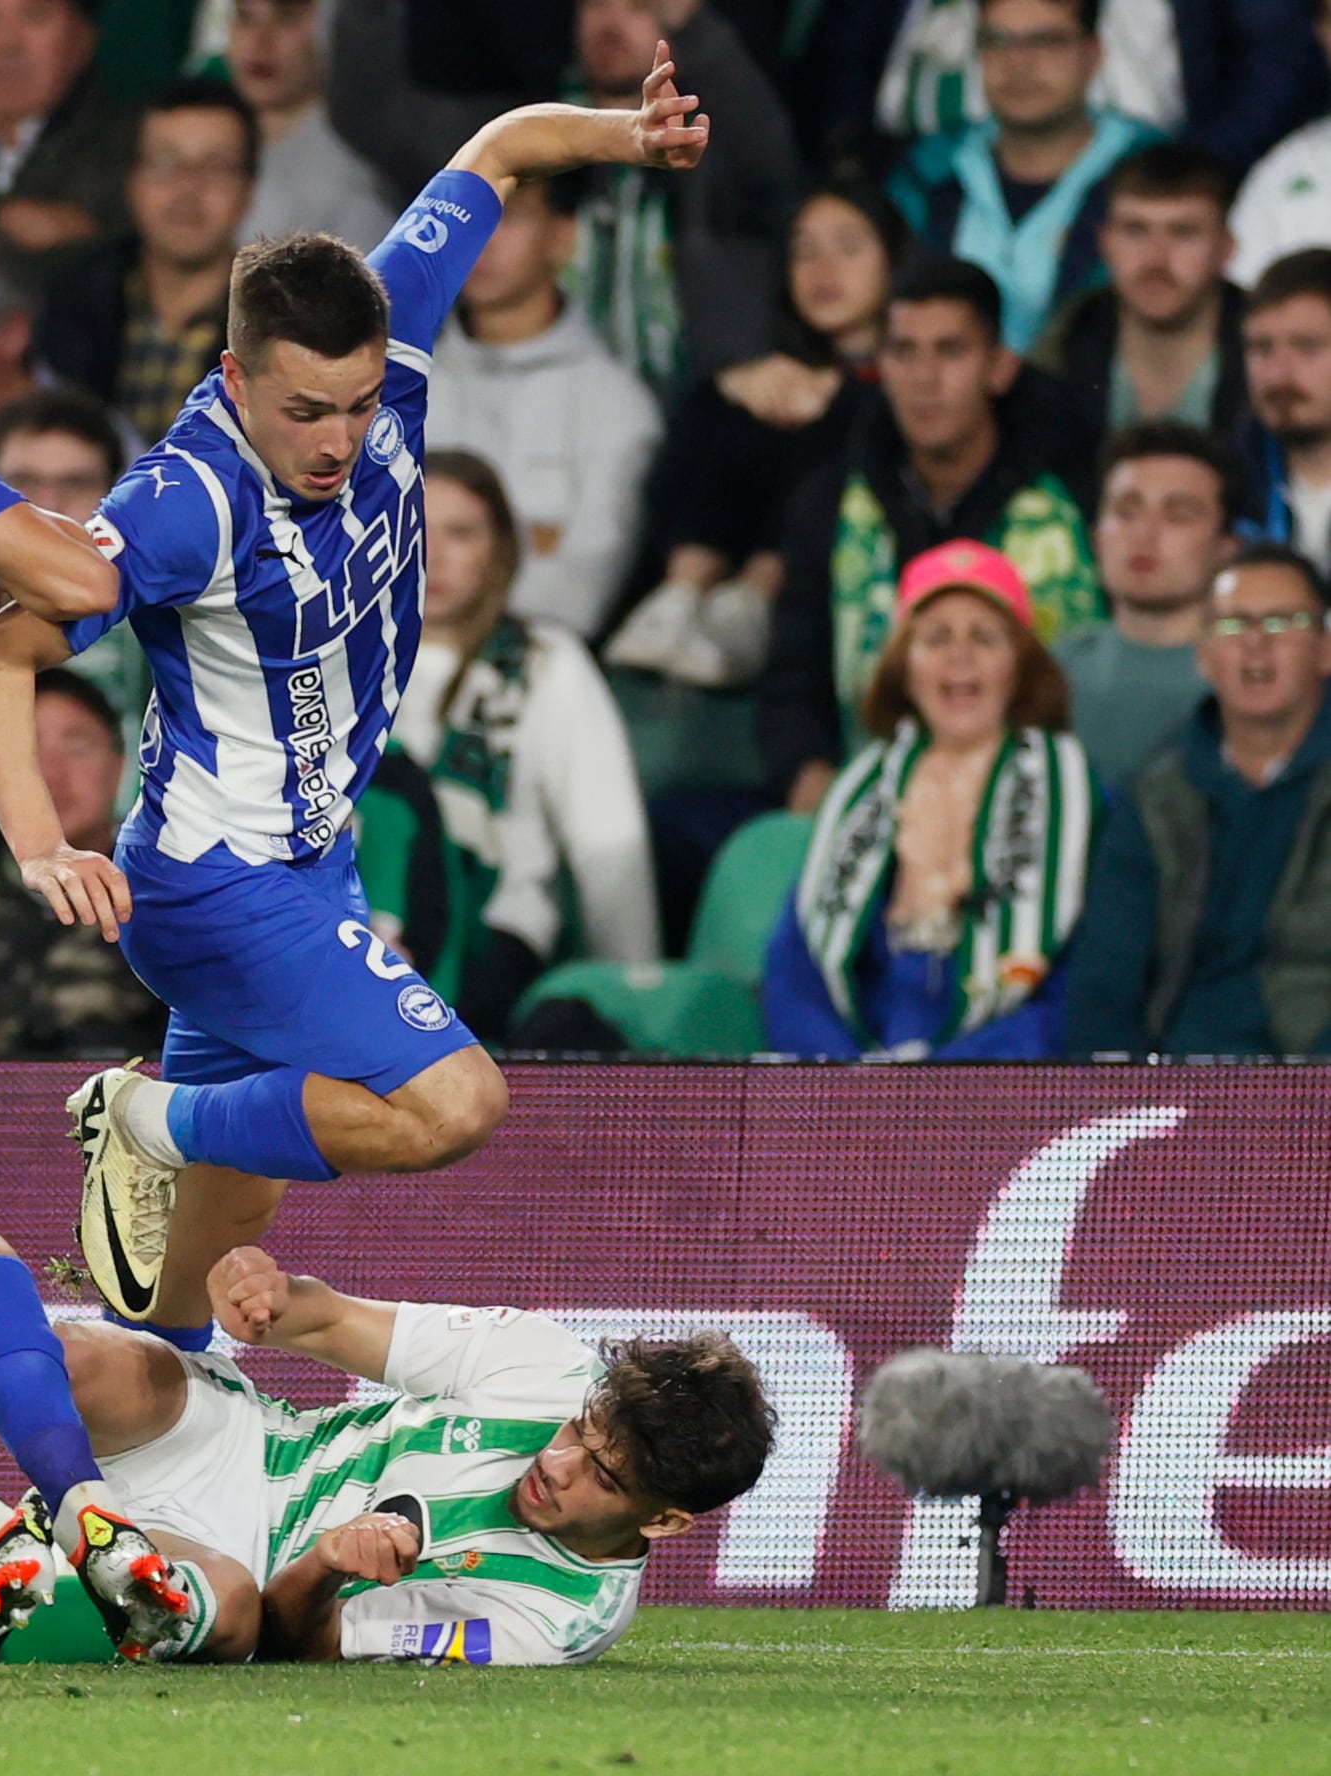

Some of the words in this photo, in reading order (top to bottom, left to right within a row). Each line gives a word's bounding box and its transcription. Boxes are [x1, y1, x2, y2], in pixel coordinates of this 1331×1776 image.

[293, 464, 426, 660] LEA
[287, 667, 337, 761] álava
[337, 919, 413, 980] 2
